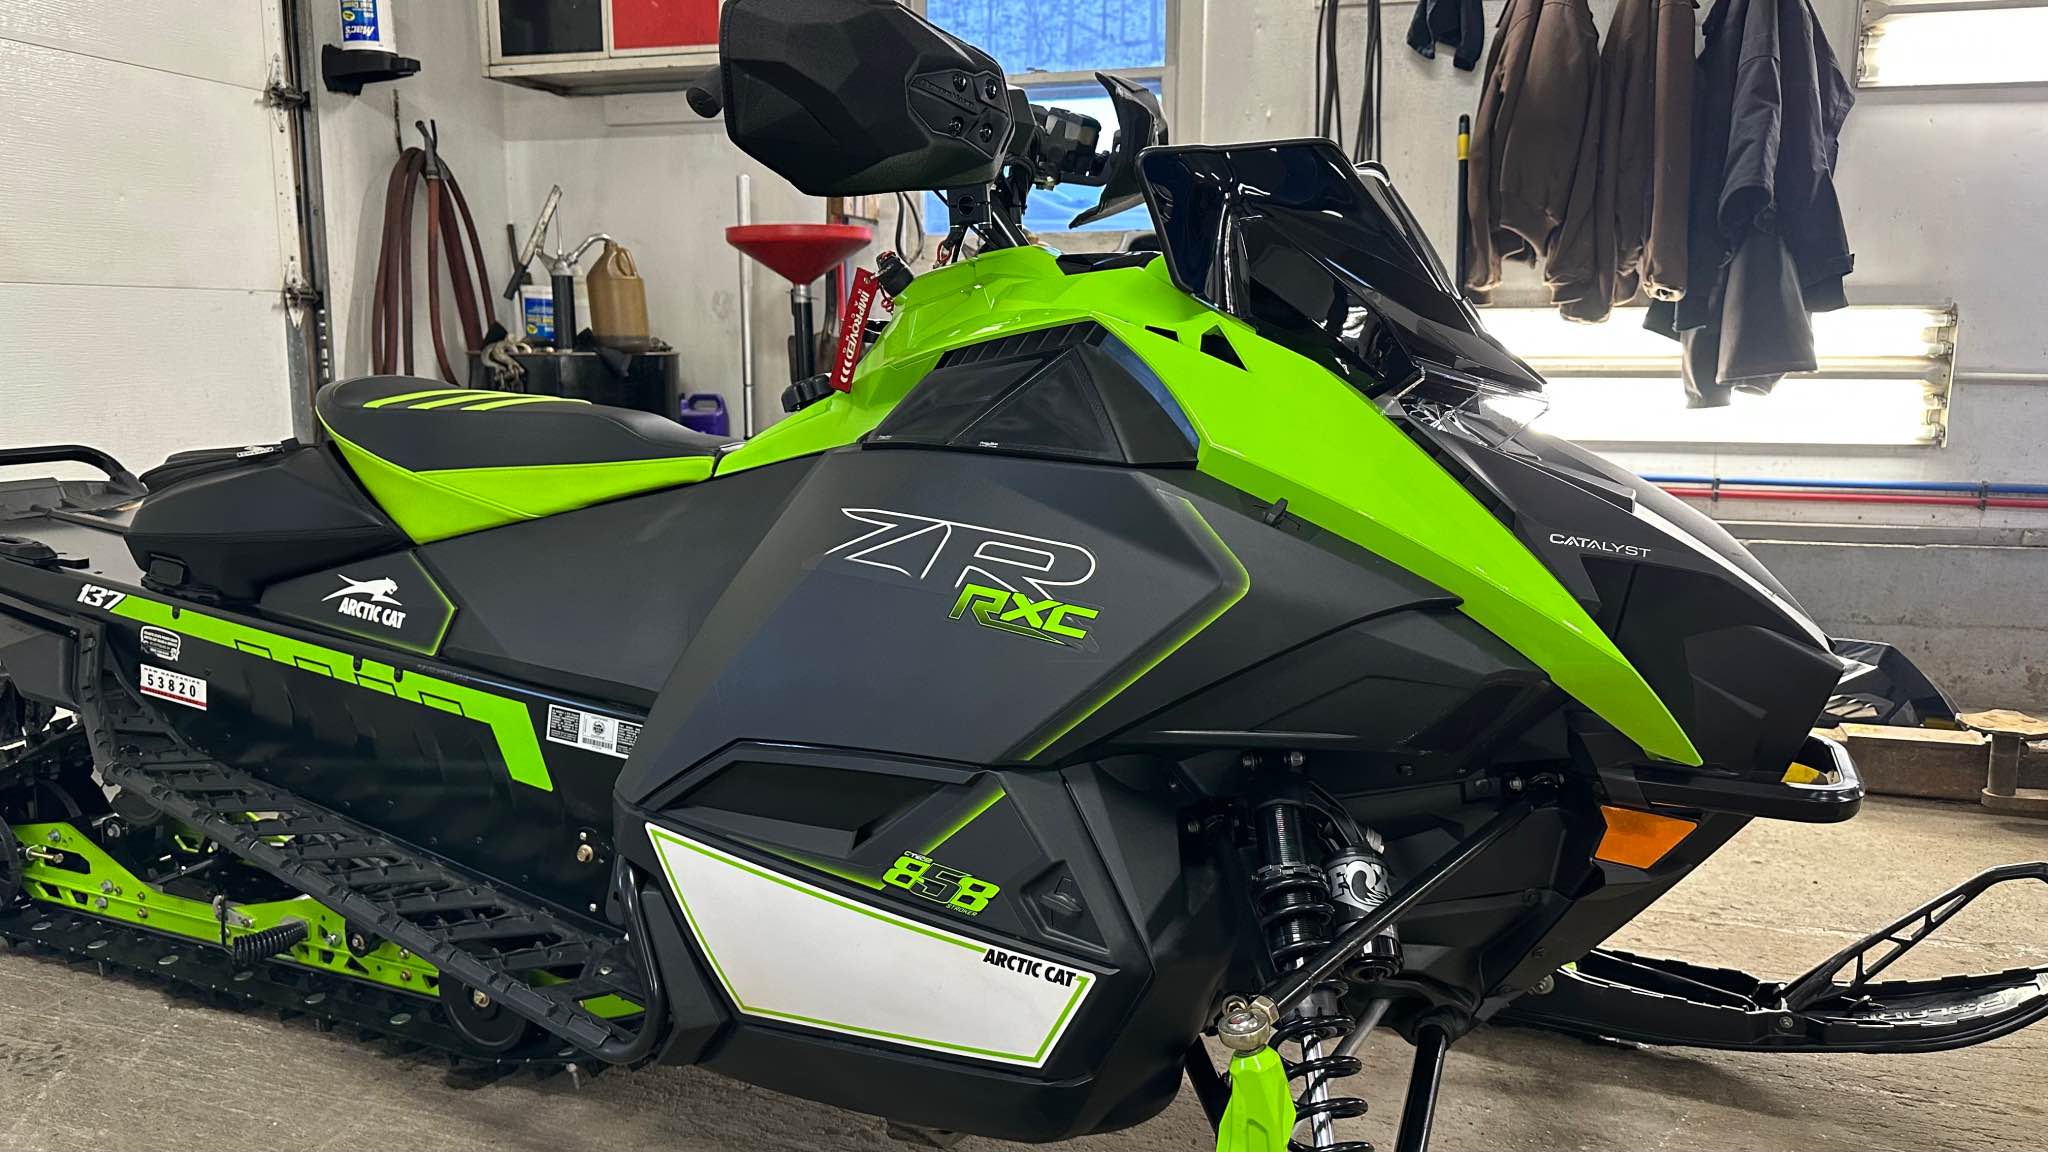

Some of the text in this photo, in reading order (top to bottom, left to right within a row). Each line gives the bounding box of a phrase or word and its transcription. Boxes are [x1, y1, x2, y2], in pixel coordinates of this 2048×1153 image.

[345, 24, 375, 37] Mac's
[842, 288, 863, 354] RACING
[846, 290, 870, 360] IMPROVED
[1549, 533, 1652, 558] CATALYST
[76, 583, 126, 610] 137
[338, 597, 407, 629] ARCTIC CAT
[948, 583, 1099, 646] RXC
[147, 673, 196, 697] 53820
[882, 856, 1000, 912] 858
[1327, 860, 1393, 907] FOX
[945, 903, 979, 917] STROKER
[983, 949, 1077, 988] ARCTIC CAT
[1862, 995, 2007, 1022] POLARI
